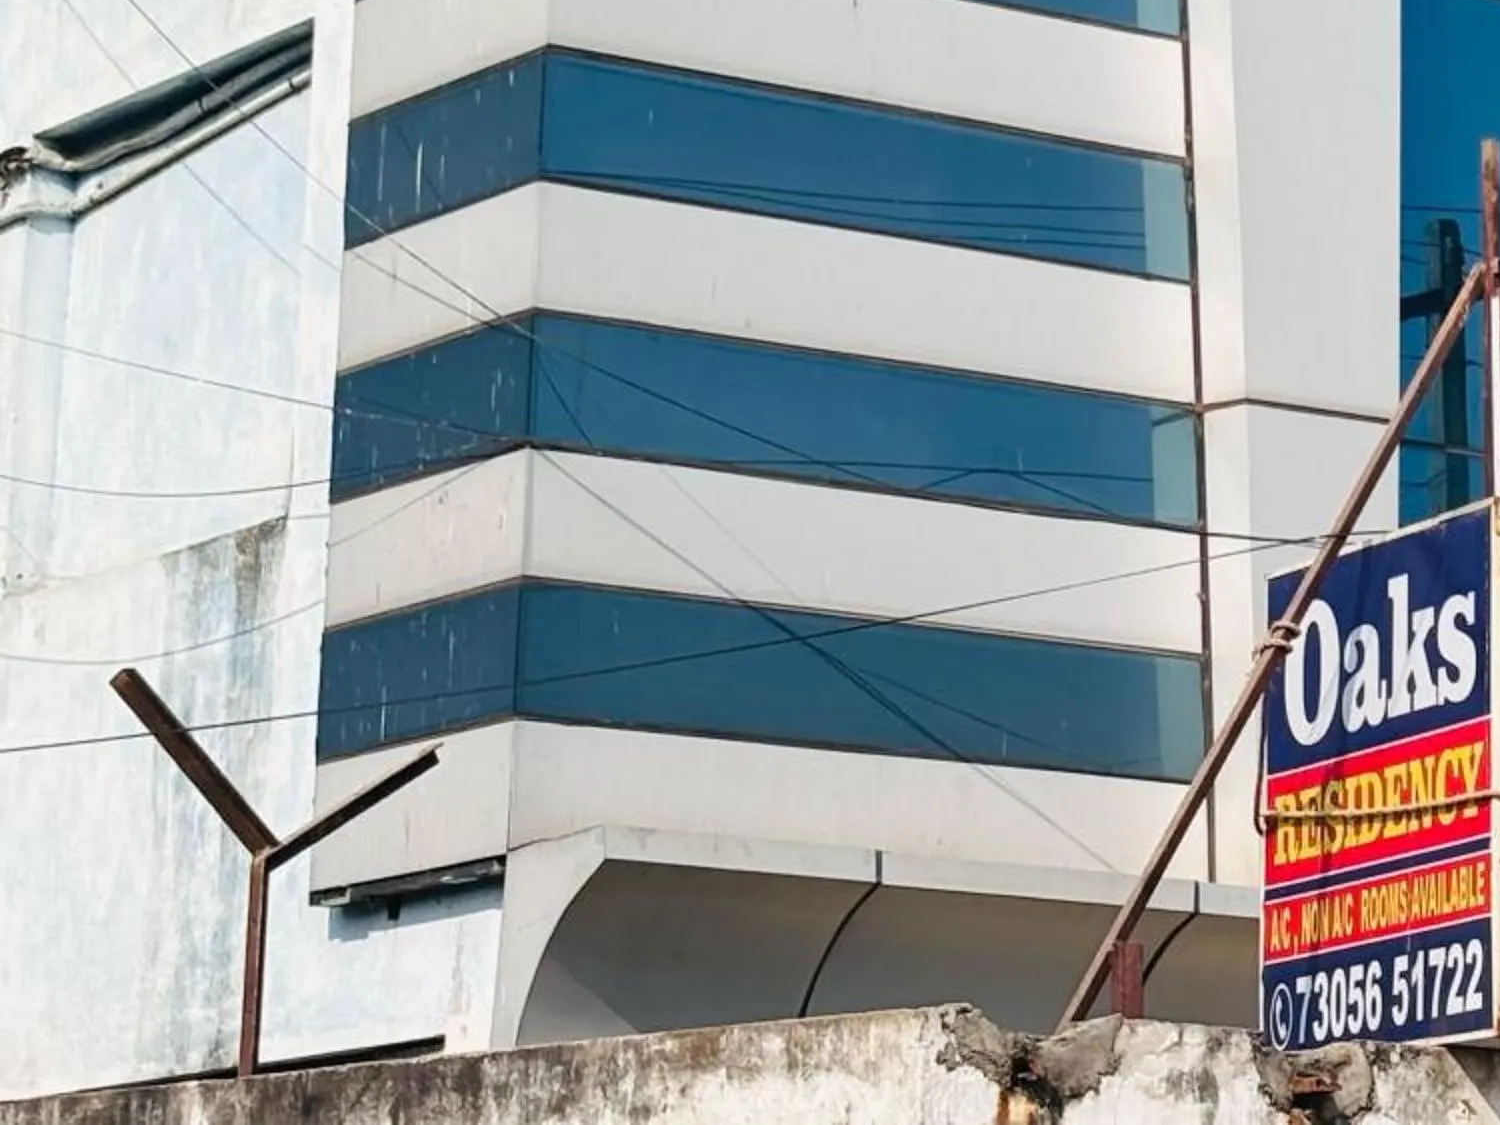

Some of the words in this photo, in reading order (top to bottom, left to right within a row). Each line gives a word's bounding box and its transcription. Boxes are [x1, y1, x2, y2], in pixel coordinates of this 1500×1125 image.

[1284, 573, 1478, 746] Oaks
[1273, 741, 1485, 866] RESIDENCY
[1301, 897, 1329, 945] NON
[1360, 879, 1408, 933] ROOMS
[1410, 860, 1486, 922] AVAILABLE
[1295, 960, 1383, 1044] 73056
[1391, 938, 1484, 1027] 51722
